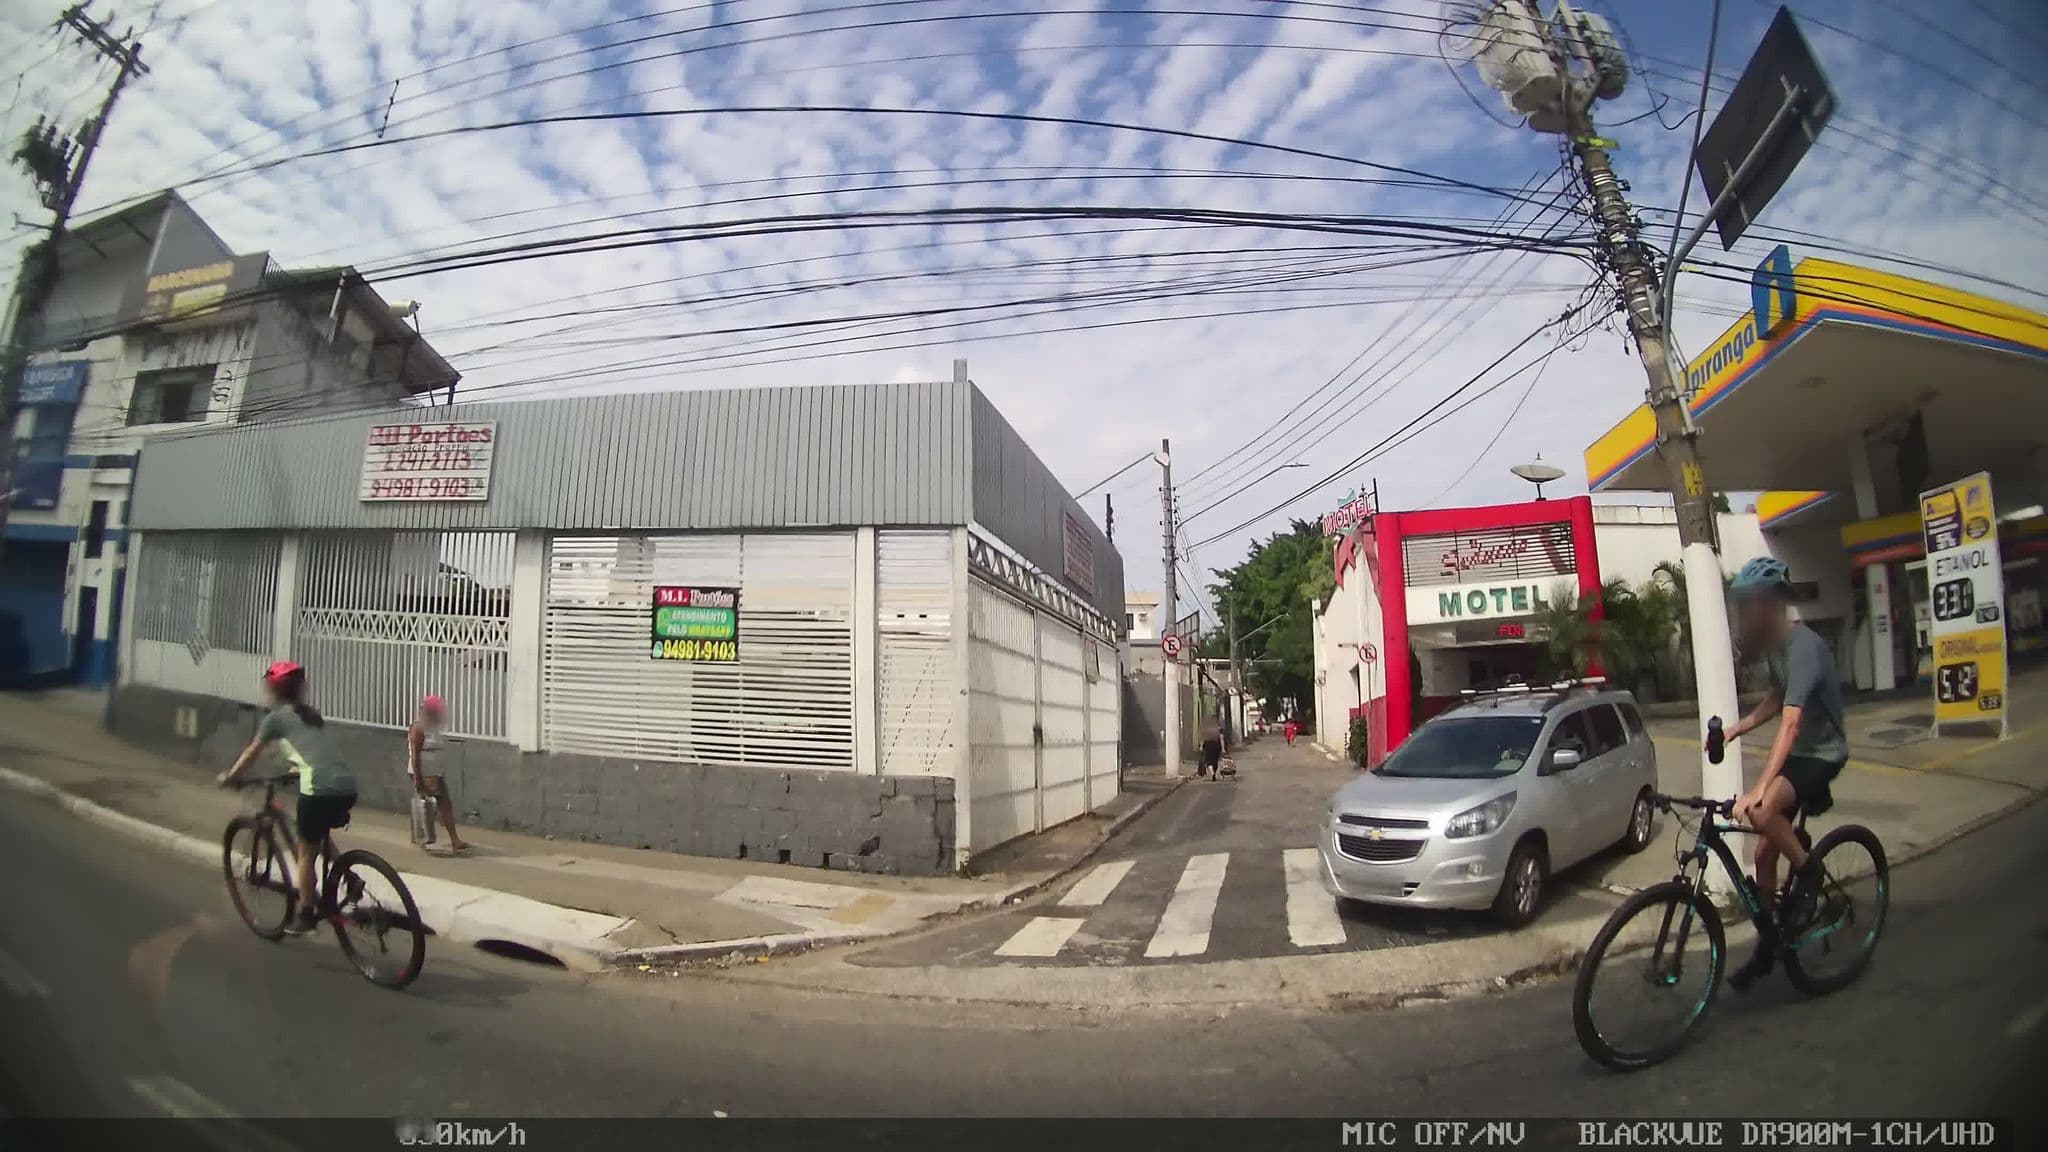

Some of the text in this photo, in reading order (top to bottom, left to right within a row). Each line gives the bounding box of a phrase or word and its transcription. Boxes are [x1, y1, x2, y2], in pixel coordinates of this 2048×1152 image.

[1683, 321, 1756, 398] piranga
[1322, 494, 1374, 537] MOTEL
[1936, 548, 1989, 577] ETANOL
[1438, 585, 1549, 617] MOTEL
[663, 639, 736, 660] 94981-9103
